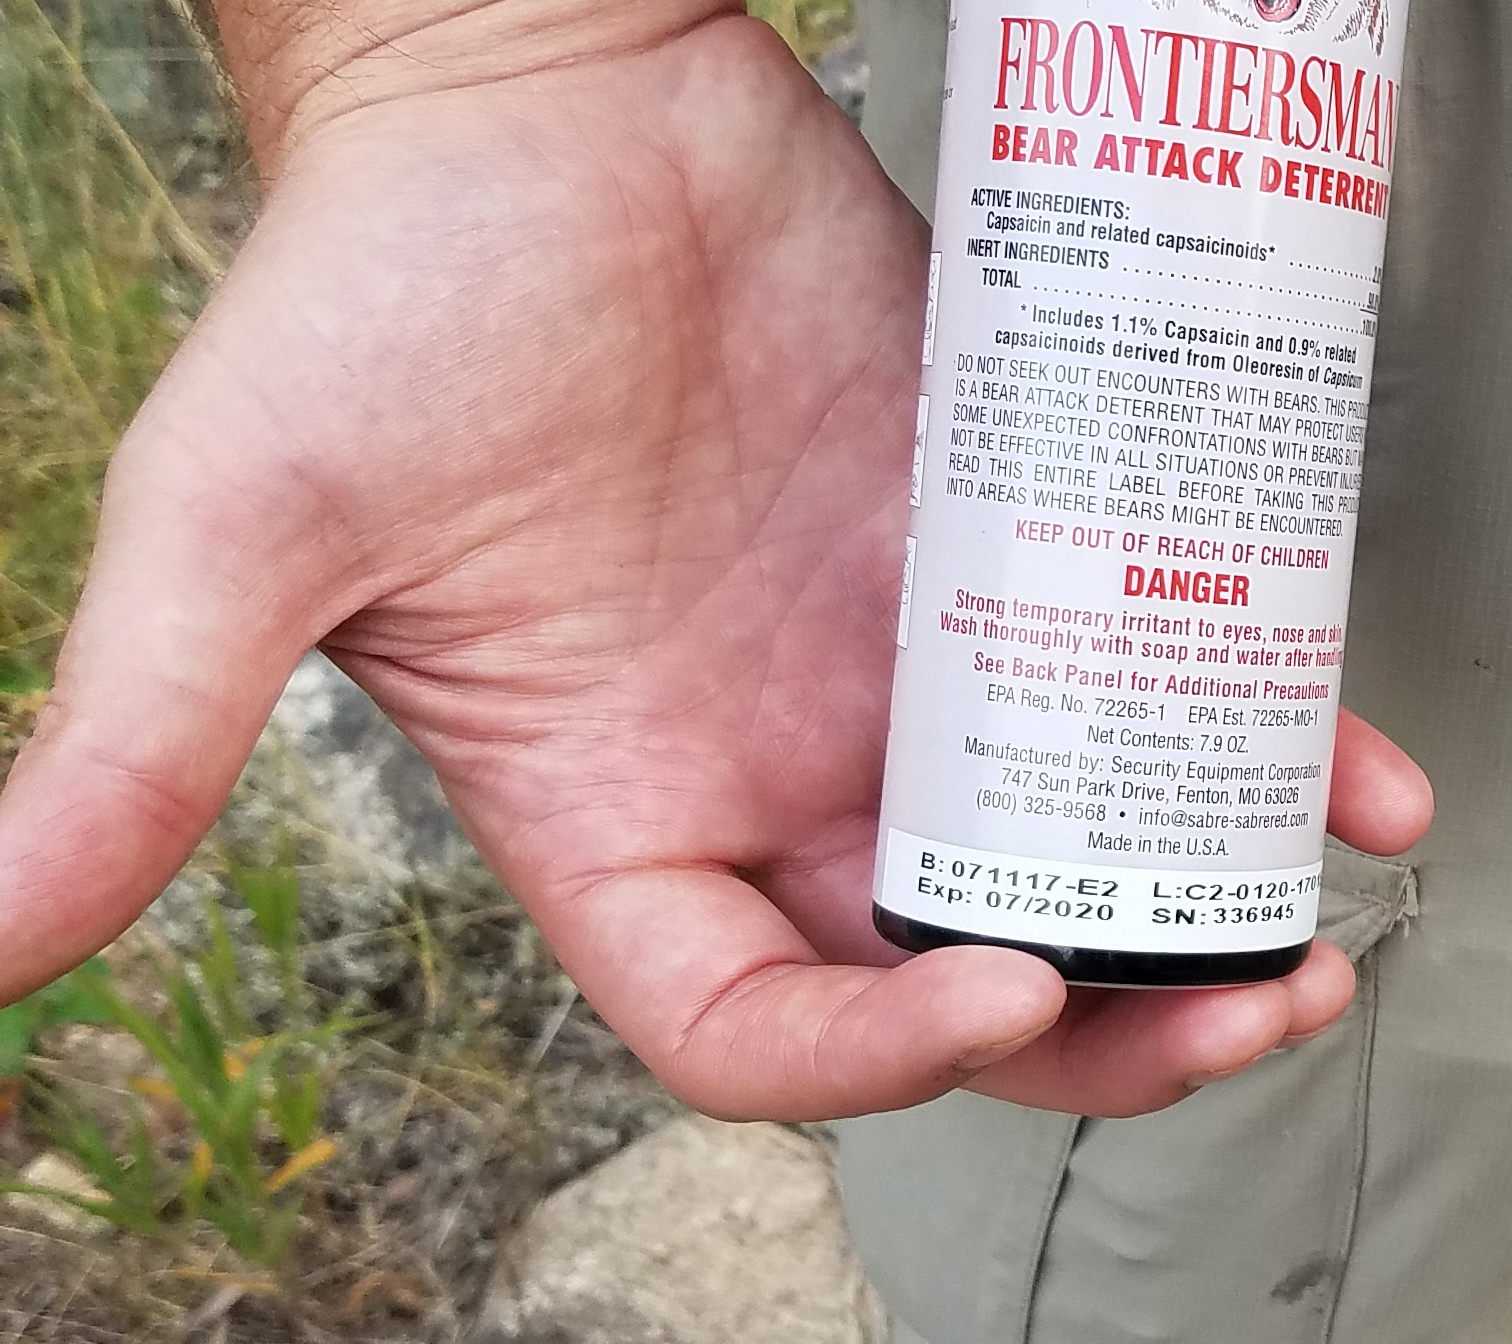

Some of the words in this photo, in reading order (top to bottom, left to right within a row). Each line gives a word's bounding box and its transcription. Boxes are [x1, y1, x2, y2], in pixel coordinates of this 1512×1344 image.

[994, 17, 1399, 172] FRONTIERSMAN
[992, 124, 1078, 167] BEAR
[1093, 134, 1243, 188] ATTACK
[1259, 155, 1389, 220] DETERRENT
[971, 188, 1012, 207] ACTIVE
[1016, 191, 1130, 219] INGREDIENTS:
[987, 211, 1050, 234] Capsaicin
[1057, 220, 1084, 237] and
[1091, 223, 1150, 245] related
[967, 238, 1000, 257] INERT
[1004, 241, 1109, 269] INGREDIENTS
[983, 268, 1022, 288] TOTAL
[995, 330, 1105, 355] capsaicinoids
[1113, 340, 1179, 364] derived
[1187, 349, 1225, 370] from
[1233, 356, 1303, 380] Oleoresin
[1308, 366, 1319, 383] of
[1033, 305, 1104, 329] Includes
[1112, 314, 1157, 336] 1.1%
[1165, 320, 1249, 347] Capsaicin
[1256, 334, 1283, 353] and
[1289, 337, 1320, 358] 0.9%
[1325, 343, 1357, 364] related
[955, 378, 966, 396] IS
[969, 380, 977, 398] A
[982, 382, 1019, 403] BEAR
[1025, 387, 1089, 411] ATTACK
[1097, 396, 1205, 424] DETERRENT
[1211, 408, 1254, 430] THAT
[1259, 414, 1291, 434] MAY
[1295, 419, 1344, 441] PROTECT
[957, 353, 973, 372] DO
[977, 356, 1005, 375] NOT
[1009, 359, 1049, 381] SEEK
[1055, 365, 1091, 385] OUT
[1097, 370, 1220, 401] ENCOUNTERS
[1227, 385, 1268, 407] WITH
[1275, 391, 1320, 414] BEARS.
[1325, 397, 1345, 417] THIS
[951, 428, 974, 446] NOT
[978, 431, 995, 450] BE
[999, 435, 1084, 461] EFFECTIVE
[1091, 445, 1108, 464] IN
[1115, 448, 1149, 469] ALL
[1156, 453, 1258, 481] SITUATIONS
[1264, 465, 1283, 484] OR
[1289, 468, 1339, 489] PREVENT
[953, 403, 987, 424] SOME
[992, 408, 1100, 437] UNEXPECTED
[1108, 422, 1266, 457] CONFRONTATIONS
[1272, 440, 1307, 461] WITH
[1312, 446, 1343, 465] BEARS
[947, 477, 973, 497] INTO
[977, 482, 1027, 504] AREAS
[1033, 489, 1097, 513] WHERE
[1104, 498, 1164, 521] BEARS
[1172, 505, 1230, 527] MIGHT
[1236, 512, 1254, 530] BE
[1260, 514, 1343, 536] ENCOUNTERED.
[949, 452, 980, 473] READ
[989, 458, 1023, 479] THIS
[1034, 464, 1097, 488] ENTIRE
[1109, 473, 1165, 496] LABEL
[1178, 481, 1245, 504] BEFORE
[1255, 488, 1303, 509] TAKING
[1312, 494, 1333, 512] THIS
[1015, 519, 1064, 543] KEEP
[1072, 527, 1115, 549] OUT
[1123, 533, 1150, 553] OF
[1157, 536, 1224, 561] REACH
[1232, 543, 1255, 563] OF
[1261, 546, 1329, 569] CHILDREN
[1124, 565, 1249, 606] DANGER
[941, 611, 977, 635] Wash
[984, 619, 1083, 653] thoroughly
[1091, 635, 1133, 655] with
[1141, 642, 1188, 664] soap
[1197, 645, 1229, 663] and
[1237, 648, 1280, 666] water
[1285, 649, 1313, 667] after
[956, 589, 1005, 619] Strong
[1013, 599, 1114, 632] temporary
[1122, 611, 1191, 636] irritant
[1199, 619, 1214, 637] to
[1223, 624, 1266, 644] eyes,
[1273, 627, 1303, 643] nose
[1308, 625, 1326, 643] and
[974, 652, 1004, 674] See
[1013, 658, 1057, 681] Back
[1065, 664, 1121, 689] Panel
[1131, 672, 1158, 691] for
[1165, 675, 1257, 698] Additional
[1263, 680, 1329, 699] Precautions
[987, 684, 1015, 704] EPA
[1021, 688, 1054, 712] Reg.
[1061, 694, 1087, 714] No.
[1095, 698, 1165, 721] 72265-1
[1189, 706, 1217, 724] EPA
[1223, 708, 1246, 726] Est.
[965, 736, 1072, 767] Manufactured
[1079, 752, 1103, 774] by:
[1111, 756, 1181, 781] Security
[1187, 762, 1264, 783] Equipment
[1268, 762, 1320, 783] Corporation
[1087, 725, 1114, 744] Net
[1120, 728, 1194, 751] Contents:
[1200, 734, 1222, 752] 7.9
[1227, 736, 1249, 753] OZ.
[977, 789, 1017, 815] (800)
[1023, 796, 1106, 821] 325-9568
[1139, 808, 1308, 829] info@sabre-sabrered.com
[1002, 768, 1032, 787] 747
[1038, 773, 1069, 793] Sun
[1076, 777, 1115, 797] Park
[1122, 781, 1169, 804] Drive,
[1177, 785, 1232, 807] Fenton,
[1239, 788, 1261, 805] MO
[1265, 787, 1299, 805] 63026
[1087, 831, 1132, 851] Made
[1138, 836, 1151, 853] in
[1158, 837, 1180, 855] the
[1186, 838, 1229, 855] U.S.A.
[918, 876, 972, 904] Exp:
[986, 891, 1113, 921] 07/2020
[1152, 903, 1294, 924] SN:336945
